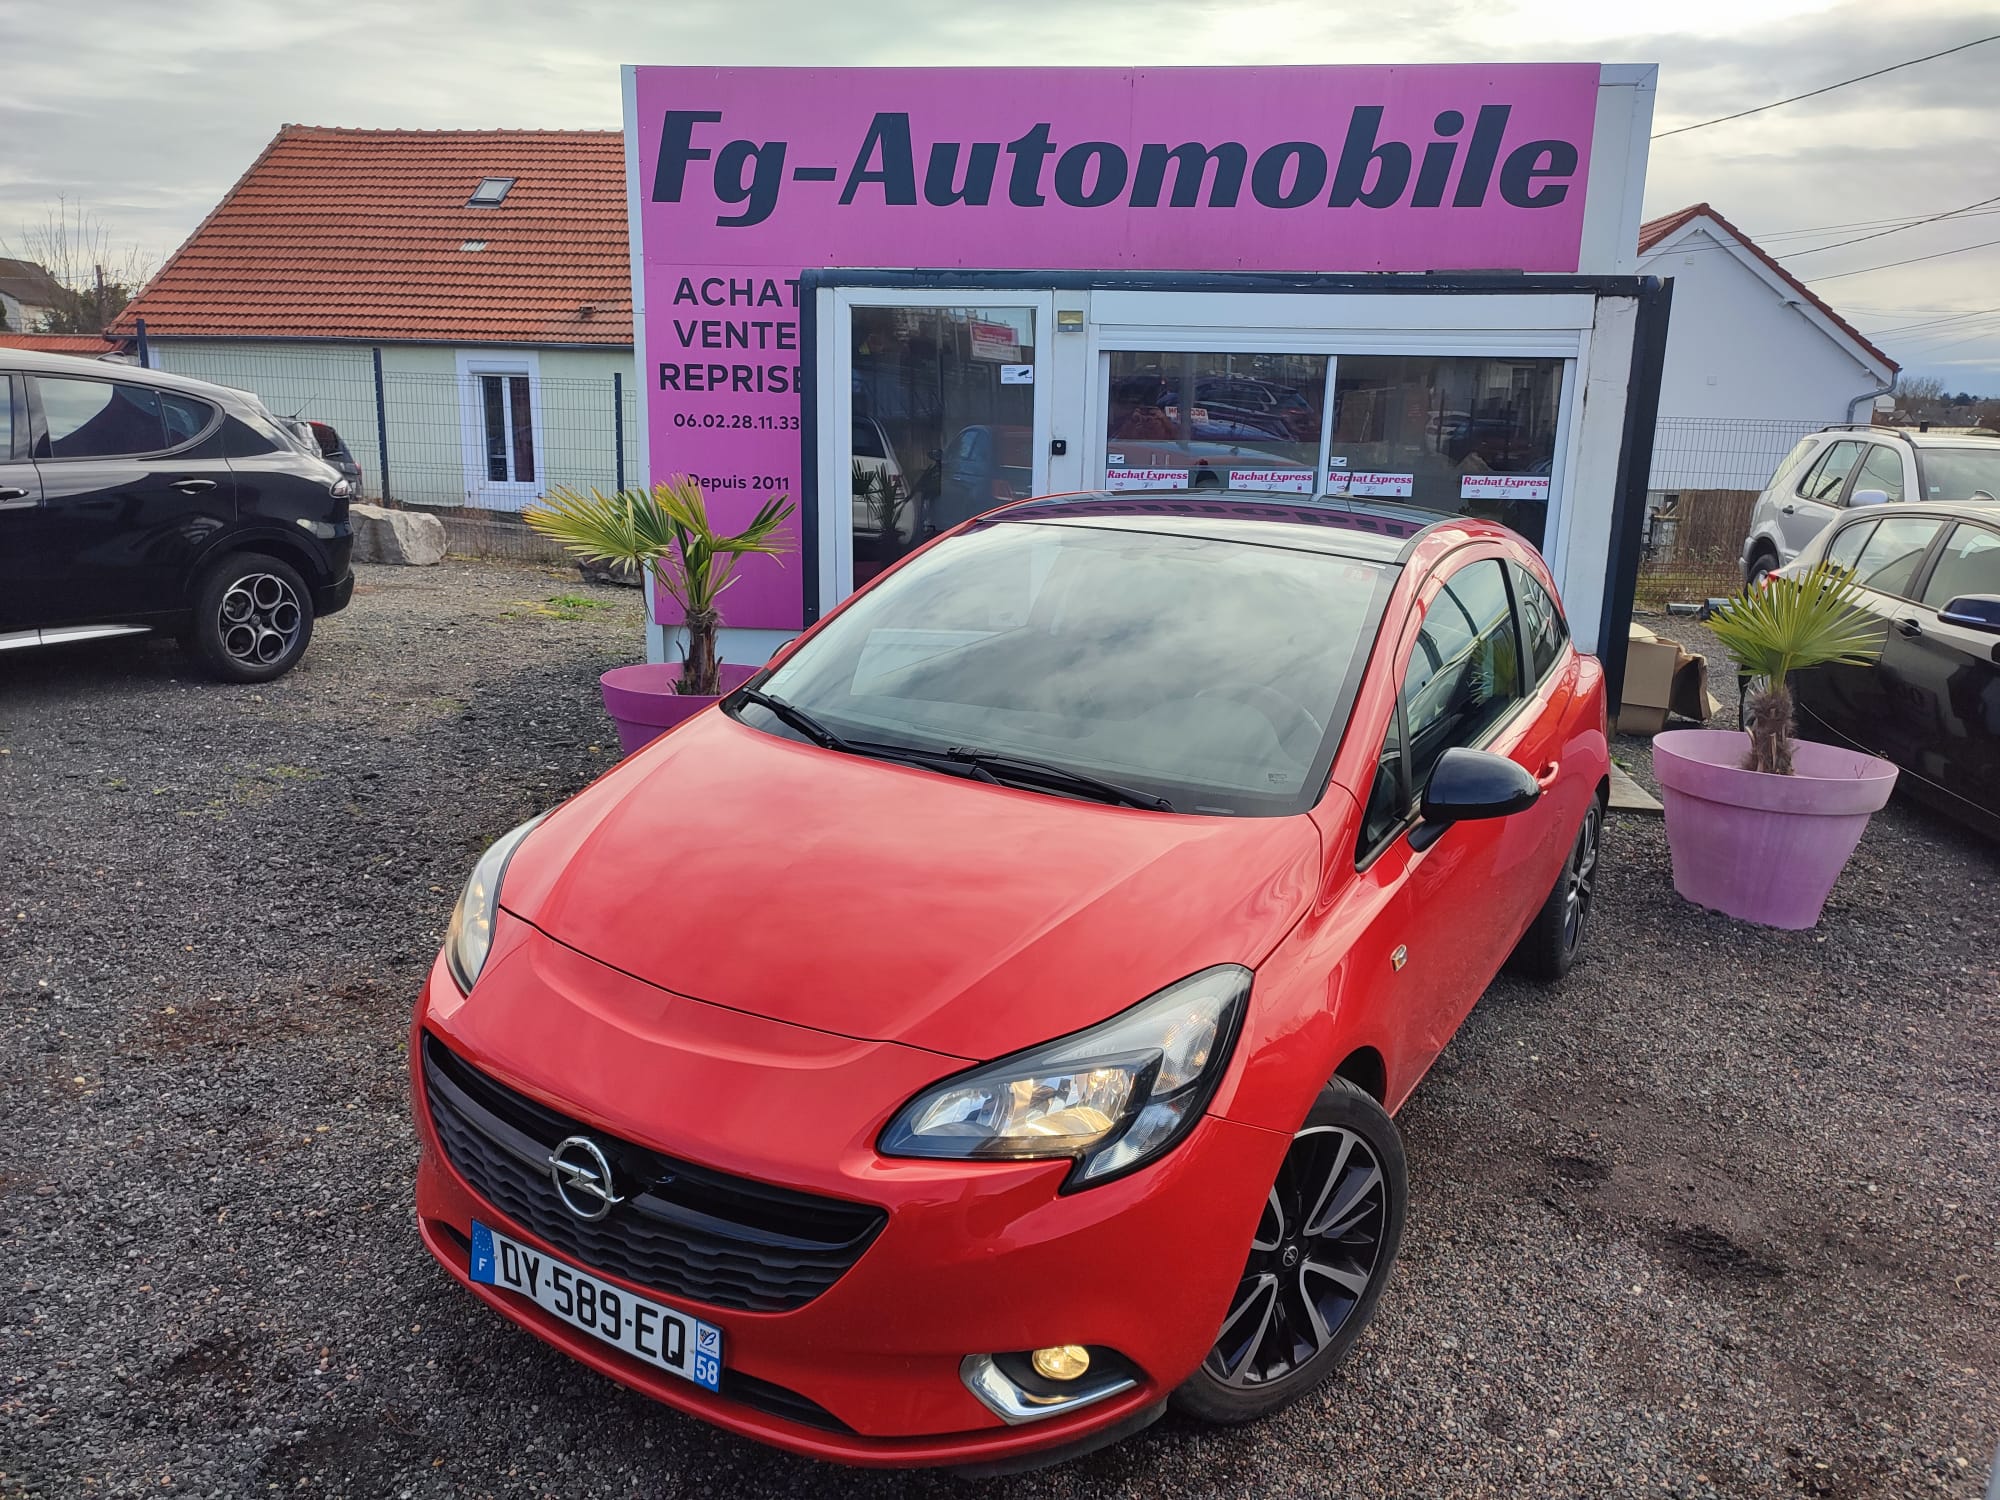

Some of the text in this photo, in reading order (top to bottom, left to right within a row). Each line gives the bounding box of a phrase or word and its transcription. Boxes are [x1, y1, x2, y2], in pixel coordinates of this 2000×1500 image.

[653, 104, 1578, 227] Fg-Automobile
[673, 277, 800, 307] ACHAT
[673, 319, 797, 350] VENTE
[673, 413, 800, 430] 06.02.28.11.33
[687, 473, 789, 492] Depuis 2011
[1107, 470, 1188, 481] Rachat Express
[1230, 470, 1313, 482] Rachat Express
[1369, 474, 1412, 485] Express
[1463, 476, 1549, 488] Rachat Express
[478, 1257, 487, 1272] F
[499, 1239, 686, 1370] DY-589-EQ
[695, 1355, 718, 1386] 58
